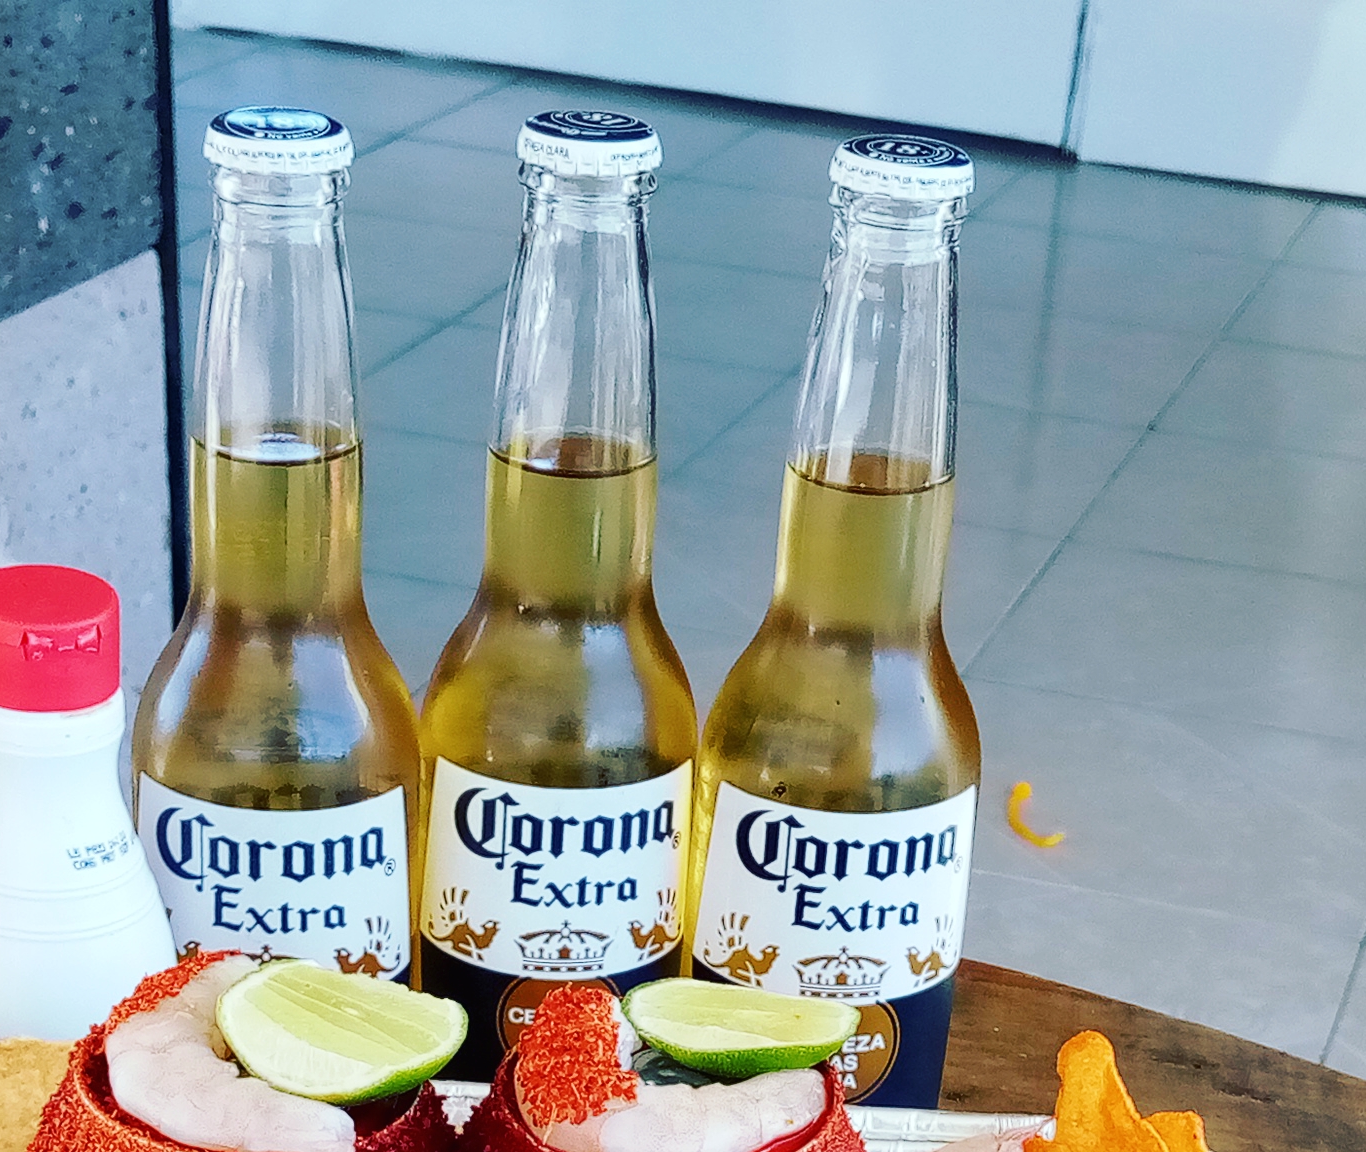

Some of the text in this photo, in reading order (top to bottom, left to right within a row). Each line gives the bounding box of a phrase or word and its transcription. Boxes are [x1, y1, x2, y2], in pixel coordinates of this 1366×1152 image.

[156, 807, 387, 892] Corona
[455, 788, 674, 870] Corona
[736, 810, 958, 893] Corona
[211, 884, 347, 934] Extra
[510, 861, 638, 908] Extra
[791, 883, 919, 932] Extra
[830, 1054, 858, 1072] AS
